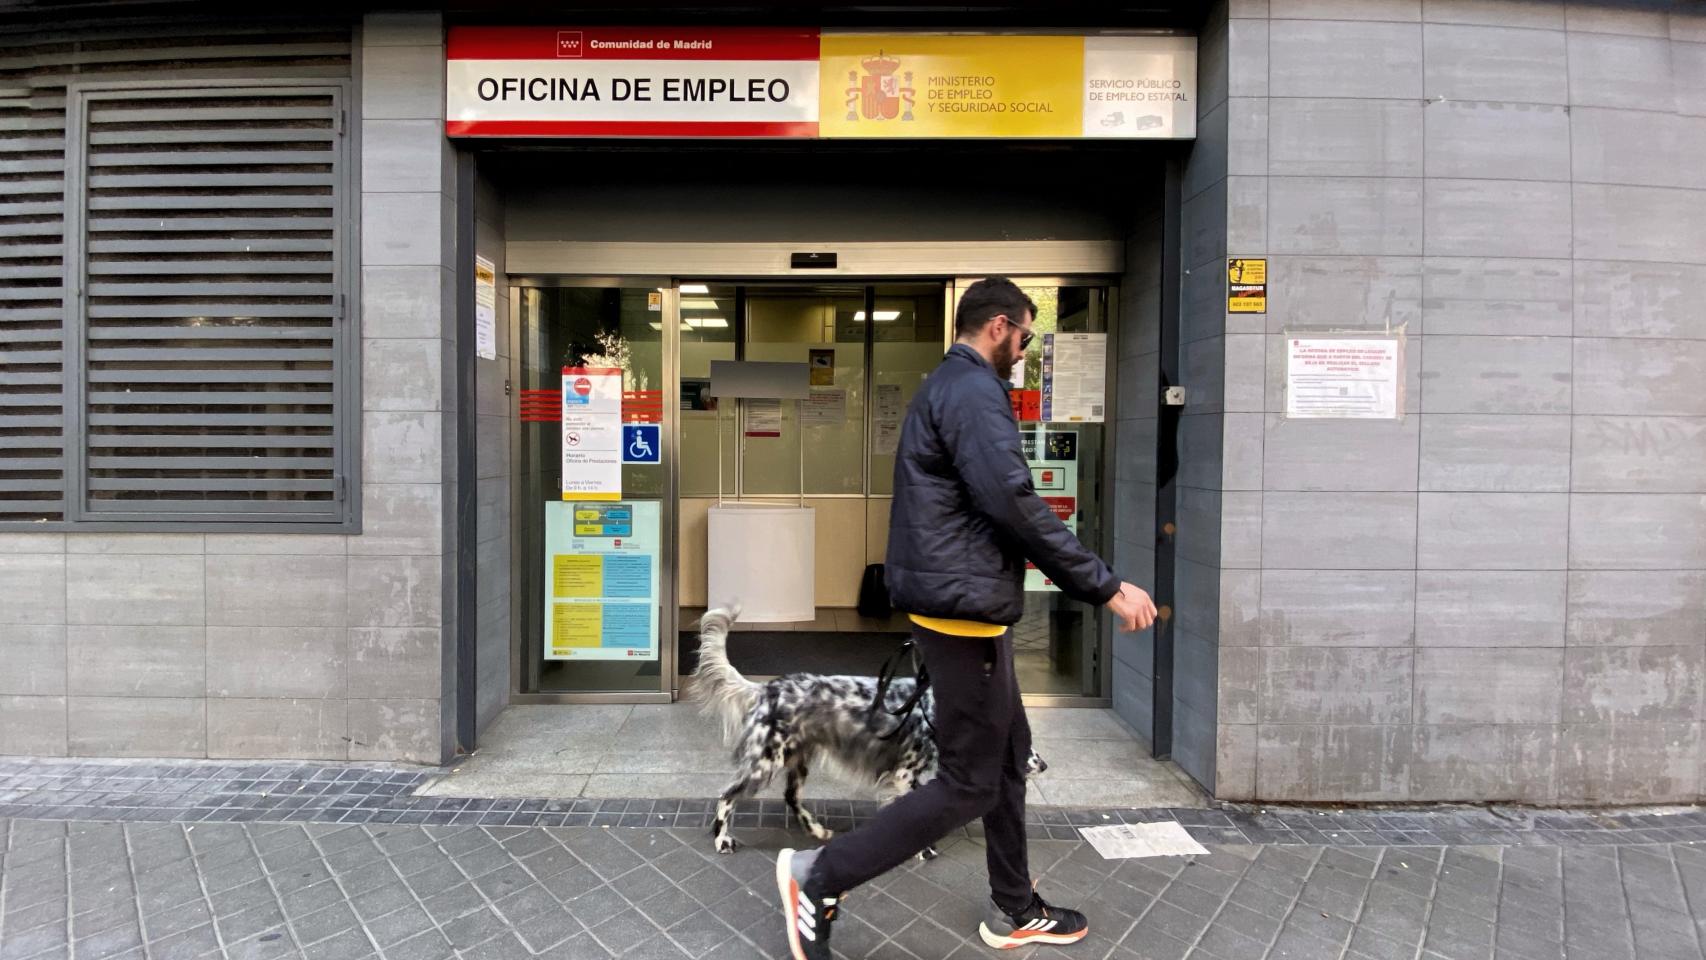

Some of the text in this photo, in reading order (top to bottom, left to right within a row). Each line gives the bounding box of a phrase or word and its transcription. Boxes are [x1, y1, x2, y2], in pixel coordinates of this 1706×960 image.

[590, 39, 712, 50] Comunidad de Madrid
[927, 76, 995, 87] MINISTERIO
[1089, 77, 1181, 89] SERVICIO PÚBLICO
[477, 77, 790, 102] OFICINA DE EMPLEO
[927, 89, 993, 100] DE EMPLEO
[1089, 92, 1188, 102] DE EMPLEO ESTATAL
[927, 102, 1053, 113] Y SEGURIDAD SOCIAL
